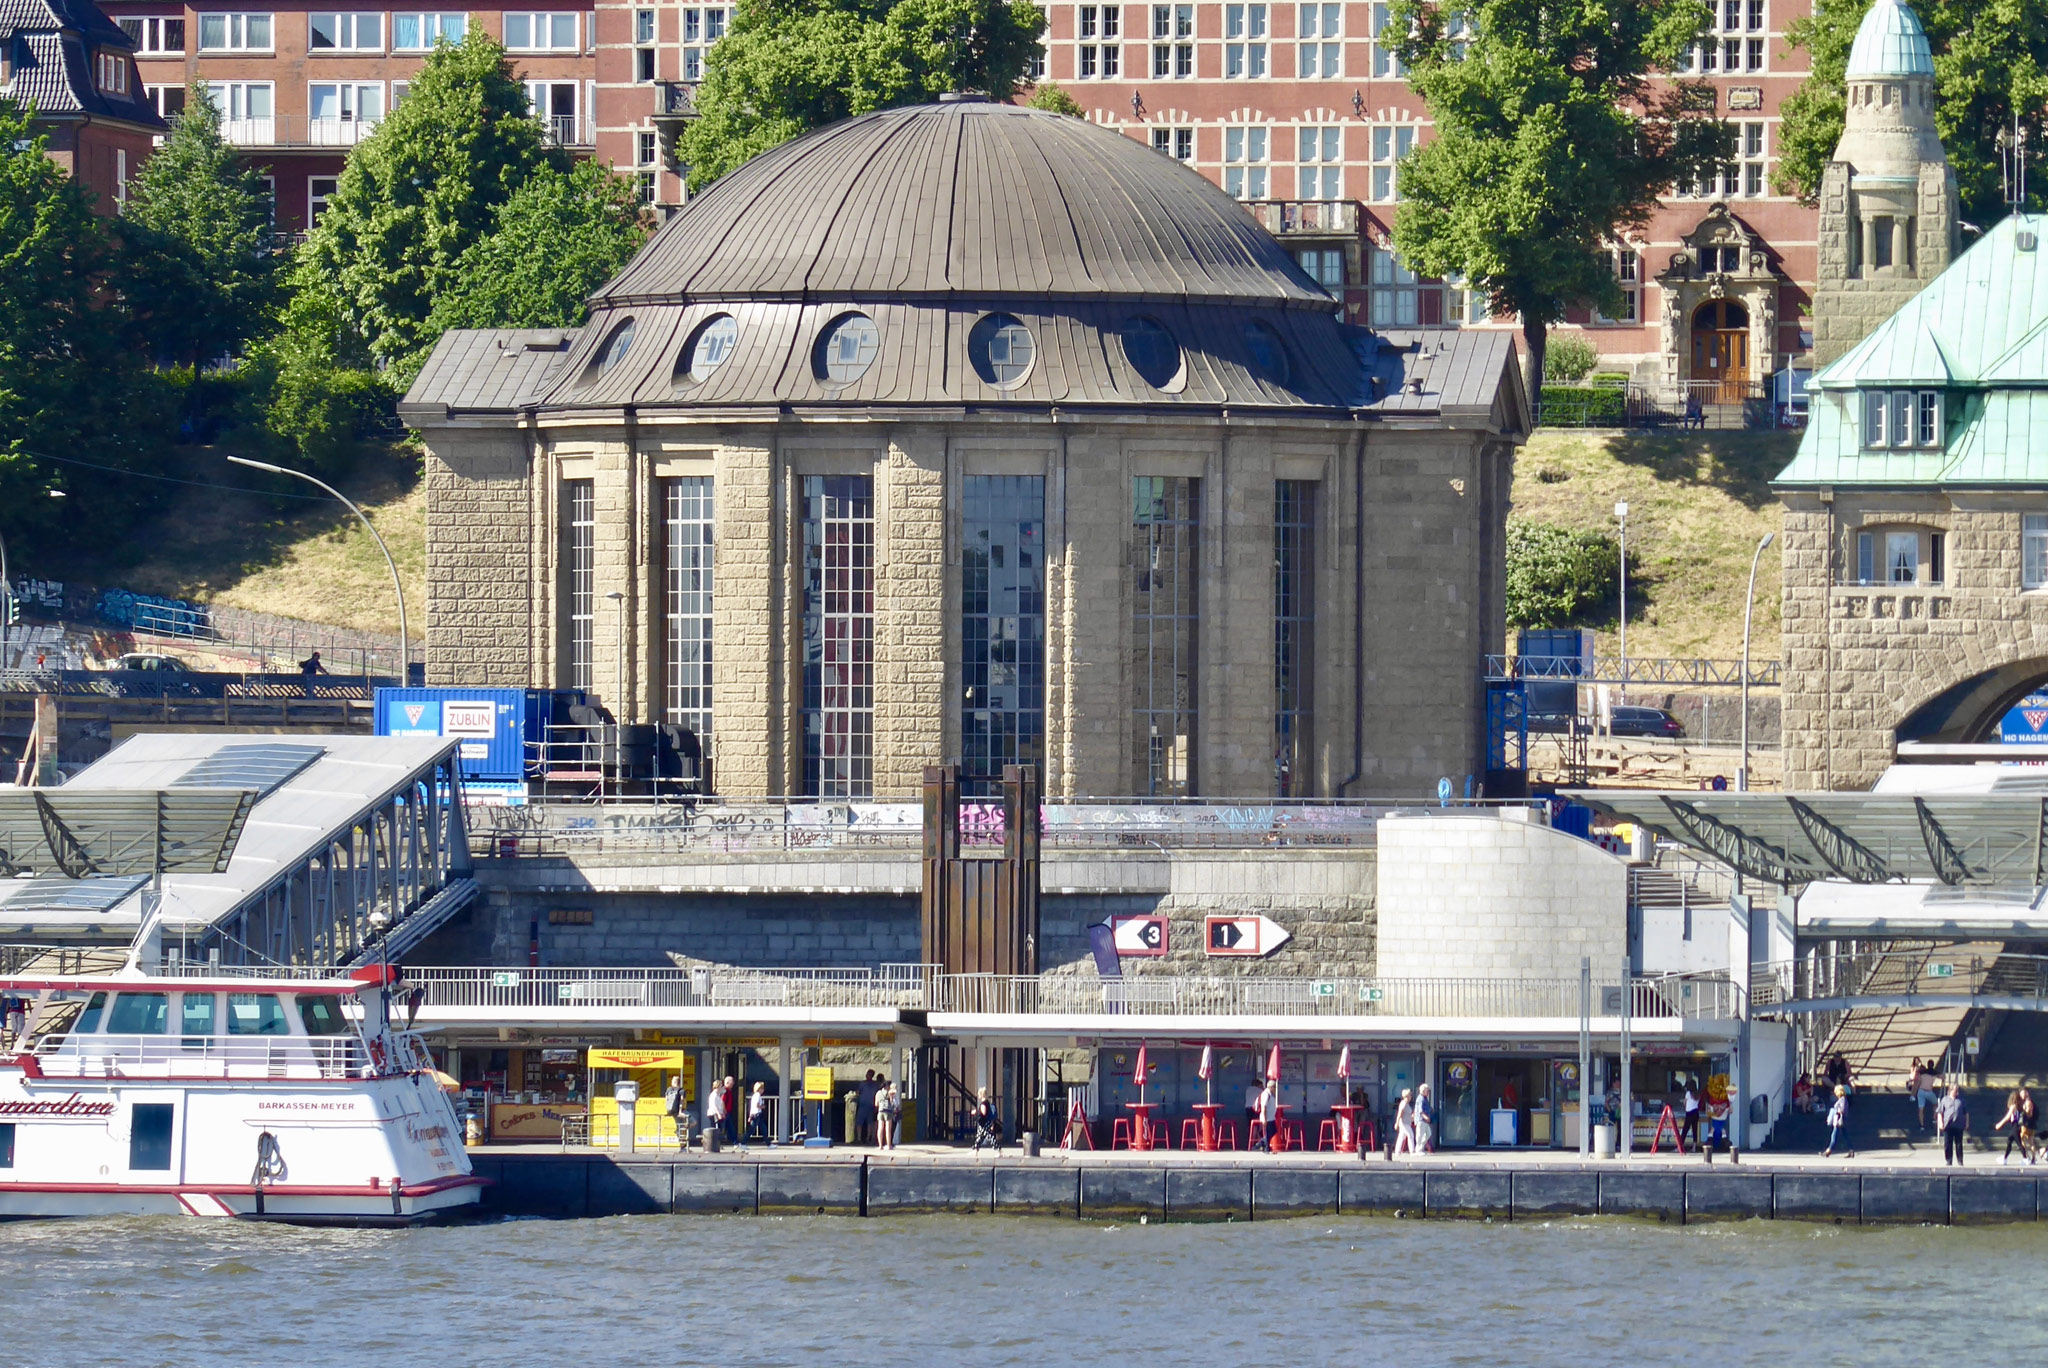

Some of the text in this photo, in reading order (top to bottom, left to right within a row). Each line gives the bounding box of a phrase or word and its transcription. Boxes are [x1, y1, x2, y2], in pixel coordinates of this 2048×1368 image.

[2004, 733, 2017, 742] HC
[1147, 926, 1161, 944] 3
[1220, 925, 1229, 946] 1
[258, 1102, 355, 1110] BARKASSEN-MEYER
